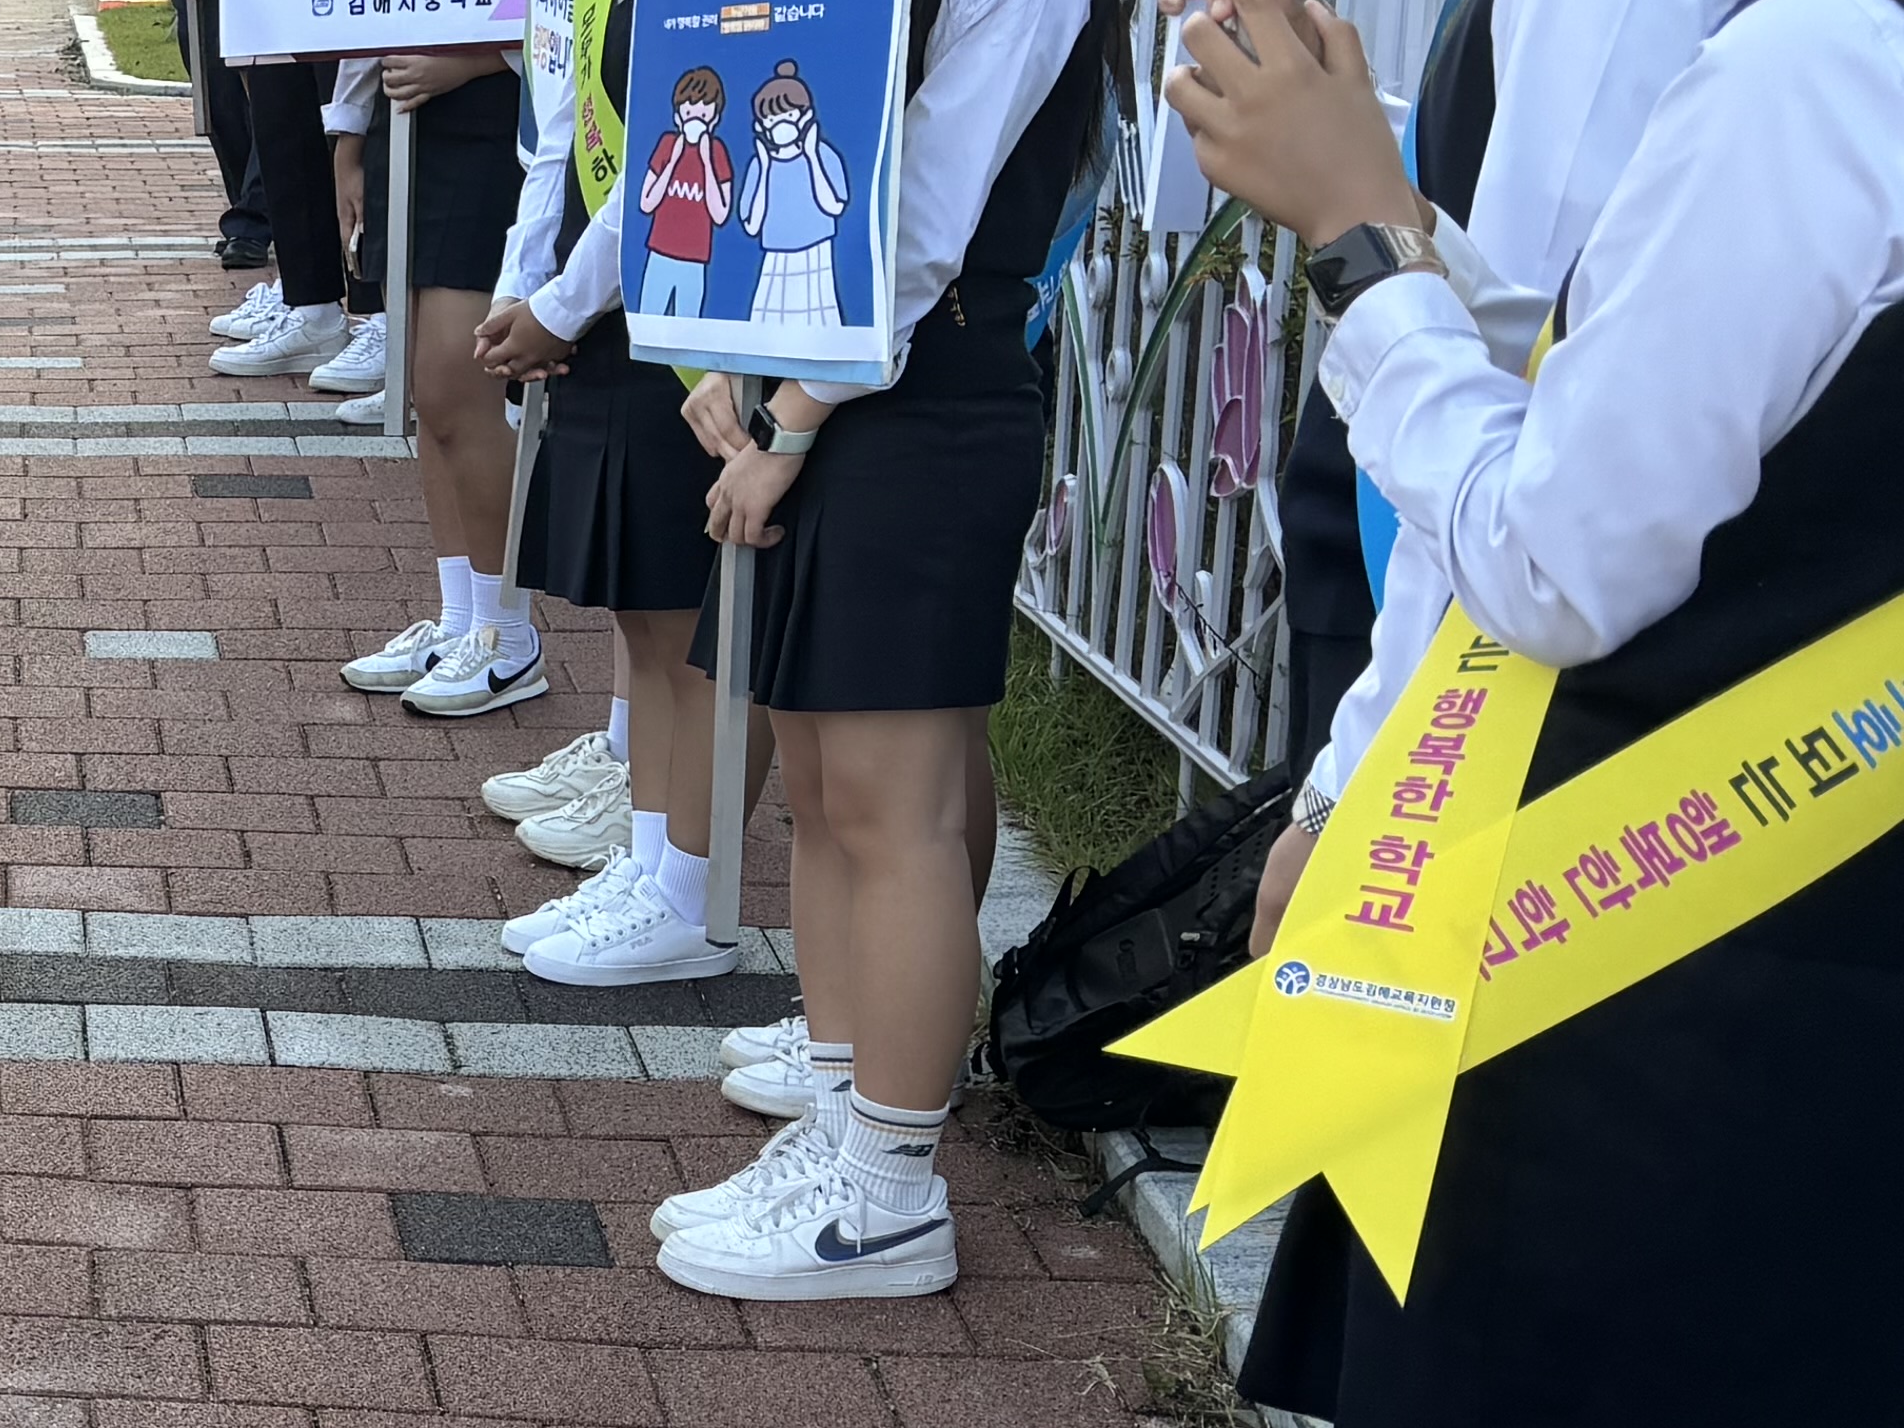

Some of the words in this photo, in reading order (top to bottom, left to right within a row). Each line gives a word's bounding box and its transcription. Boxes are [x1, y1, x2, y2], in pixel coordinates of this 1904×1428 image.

[774, 3, 825, 23] 같습니다
[1390, 687, 1489, 822] 행복한
[1344, 835, 1435, 933] 학교
[1564, 787, 1743, 920] 행복한
[1316, 974, 1456, 1013] 경상남도김해교육지원청
